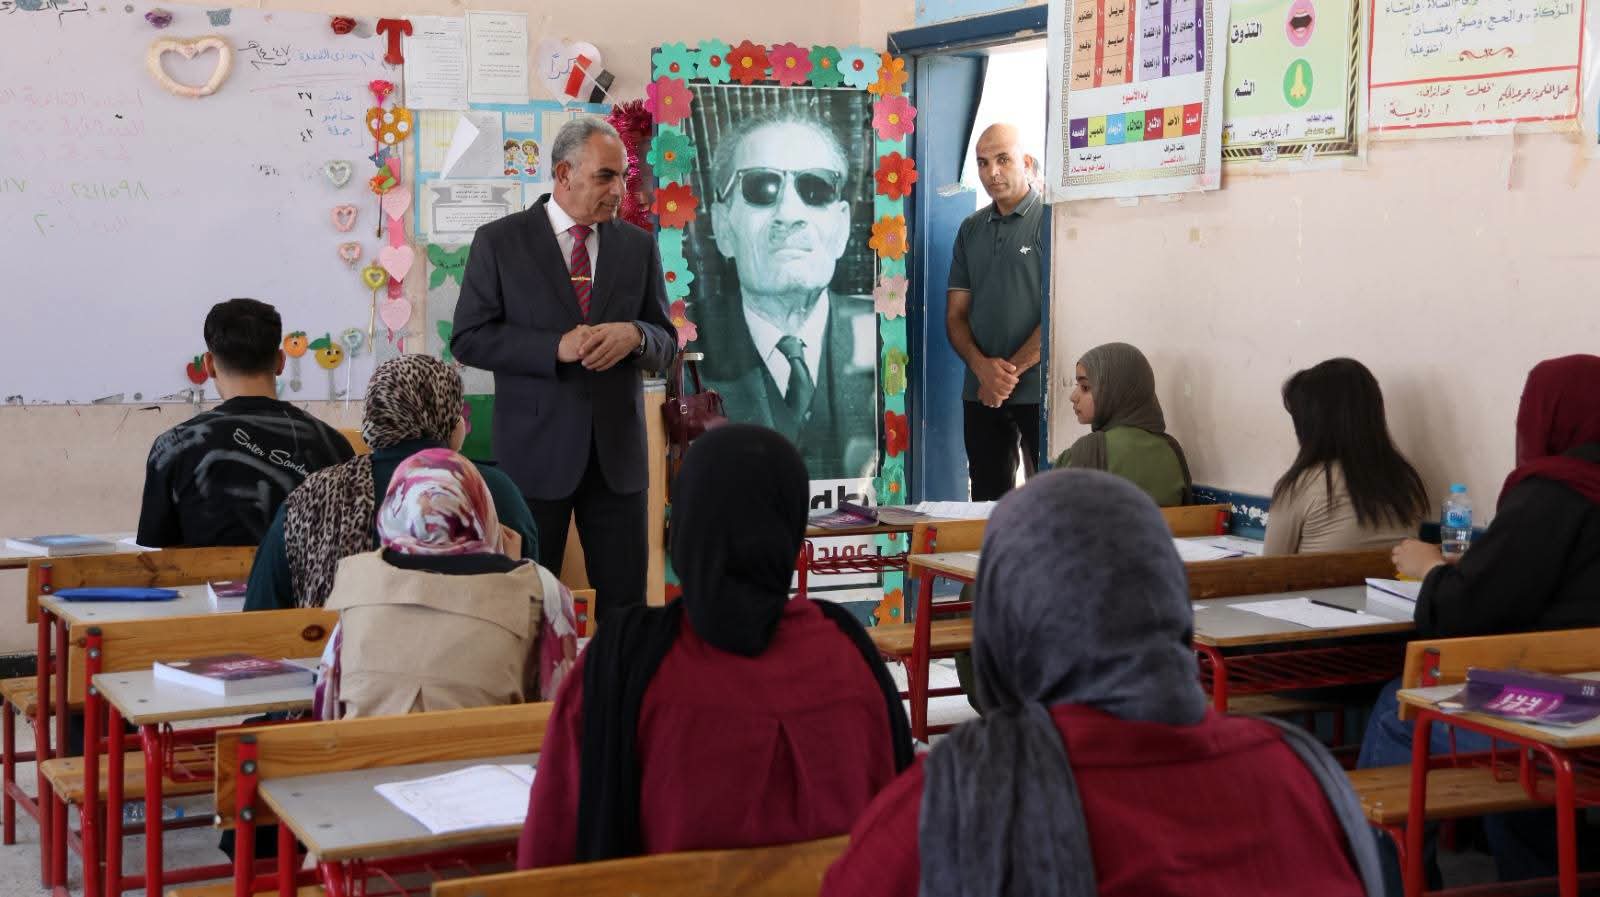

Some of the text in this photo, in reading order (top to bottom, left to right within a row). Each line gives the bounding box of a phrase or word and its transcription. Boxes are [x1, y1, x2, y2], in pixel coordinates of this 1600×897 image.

[1230, 22, 1262, 44] التذوق
[1234, 80, 1255, 100] الشم
[233, 428, 266, 457] Enter
